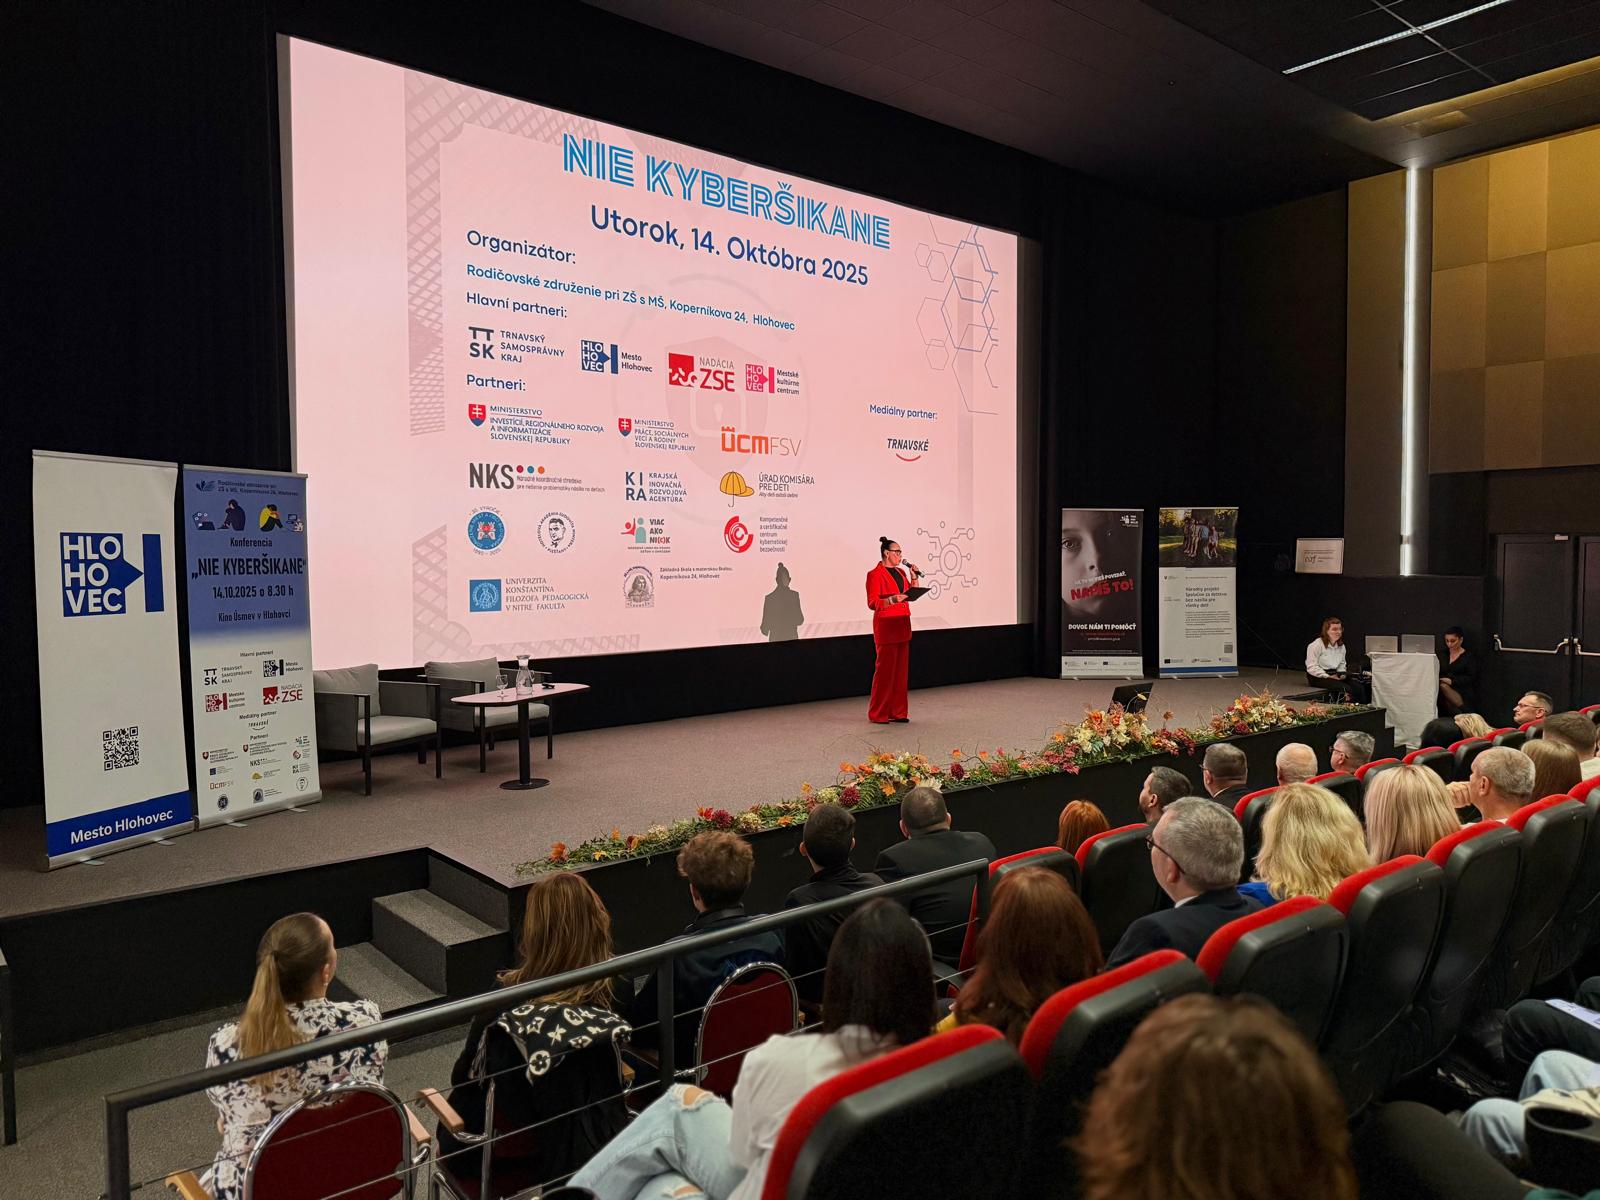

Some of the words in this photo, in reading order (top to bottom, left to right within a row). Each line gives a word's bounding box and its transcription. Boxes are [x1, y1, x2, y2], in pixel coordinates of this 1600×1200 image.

[563, 133, 635, 187] NIE
[646, 154, 890, 250] KYBERŠIKANE
[467, 230, 576, 265] Organizátor:
[591, 204, 685, 249] Utorok,
[691, 228, 720, 256] 14.
[727, 236, 816, 276] Októbra
[822, 257, 868, 285] 2025
[466, 264, 541, 287] Rodičovské
[543, 279, 601, 297] združenie
[605, 289, 620, 301] pri
[622, 290, 637, 303] ZŠ
[640, 296, 646, 305] s
[648, 295, 667, 310] MŠ,
[734, 311, 748, 324] 24,
[753, 314, 796, 331] Hlohovec
[466, 291, 510, 309] Hlavní
[512, 300, 567, 318] partneri:
[468, 326, 495, 341] TT
[500, 330, 546, 343] TRNAVSKÝ
[469, 342, 495, 360] SK
[500, 342, 565, 357] SAMOSPRÁVNY
[582, 341, 603, 353] HLO
[500, 353, 523, 363] KRAJ
[582, 351, 599, 361] HO
[621, 352, 642, 362] Mesto
[582, 361, 604, 372] VEC
[621, 362, 653, 373] Hlohovec
[699, 356, 735, 370] NADÁCIA
[746, 365, 763, 375] HLO
[776, 369, 800, 379] Mestské
[466, 374, 526, 392] Partneri:
[699, 368, 735, 392] ZSE
[746, 374, 759, 383] HO
[776, 378, 800, 387] kultúrne
[747, 382, 763, 392] VEC
[776, 387, 800, 395] centrum
[489, 405, 543, 416] MINISTERSTVO
[869, 404, 906, 418] Mediálny
[907, 409, 938, 420] partner:
[525, 420, 576, 430] REGIONÁLNEHO
[576, 424, 604, 434] ROZVOJA
[634, 419, 675, 428] MINISTERSTVO
[496, 426, 552, 436] INFORMATIZÁCIE
[490, 433, 533, 443] SLOVENSKEJ
[535, 436, 571, 445] REPUBLIKY
[887, 438, 929, 452] TRNAVSKÉ
[469, 462, 515, 490] NKS
[758, 472, 778, 483] ÚRAD
[779, 474, 815, 485] KOMISÁRA
[649, 480, 682, 488] INOVAČNÁ
[759, 483, 773, 491] PRE
[773, 484, 790, 492] DETI
[625, 487, 647, 501] RA
[649, 488, 687, 496] ROZVOJOVÁ
[649, 518, 665, 526] VIAC
[62, 535, 122, 561] HLO
[230, 537, 273, 547] Konferencia
[64, 562, 110, 588] HO
[505, 577, 547, 585] UNIVERZITA
[1112, 578, 1134, 593] TO!
[213, 586, 257, 599] 14.10.2025
[259, 588, 265, 597] o
[267, 585, 286, 597] 8.30
[288, 585, 294, 596] h
[542, 592, 589, 601] PEDAGOGICKÁ
[65, 587, 123, 614] VEC
[505, 595, 539, 603] FILOZOFA
[218, 612, 233, 622] Kino
[233, 610, 256, 621] Úsmev
[263, 609, 291, 620] Hlohovci
[1088, 622, 1104, 630] NÁM
[204, 668, 218, 676] TT
[204, 676, 218, 686] SK
[281, 689, 303, 703] ZSE
[70, 825, 113, 845] Mesto
[115, 809, 174, 834] Hlohovec
